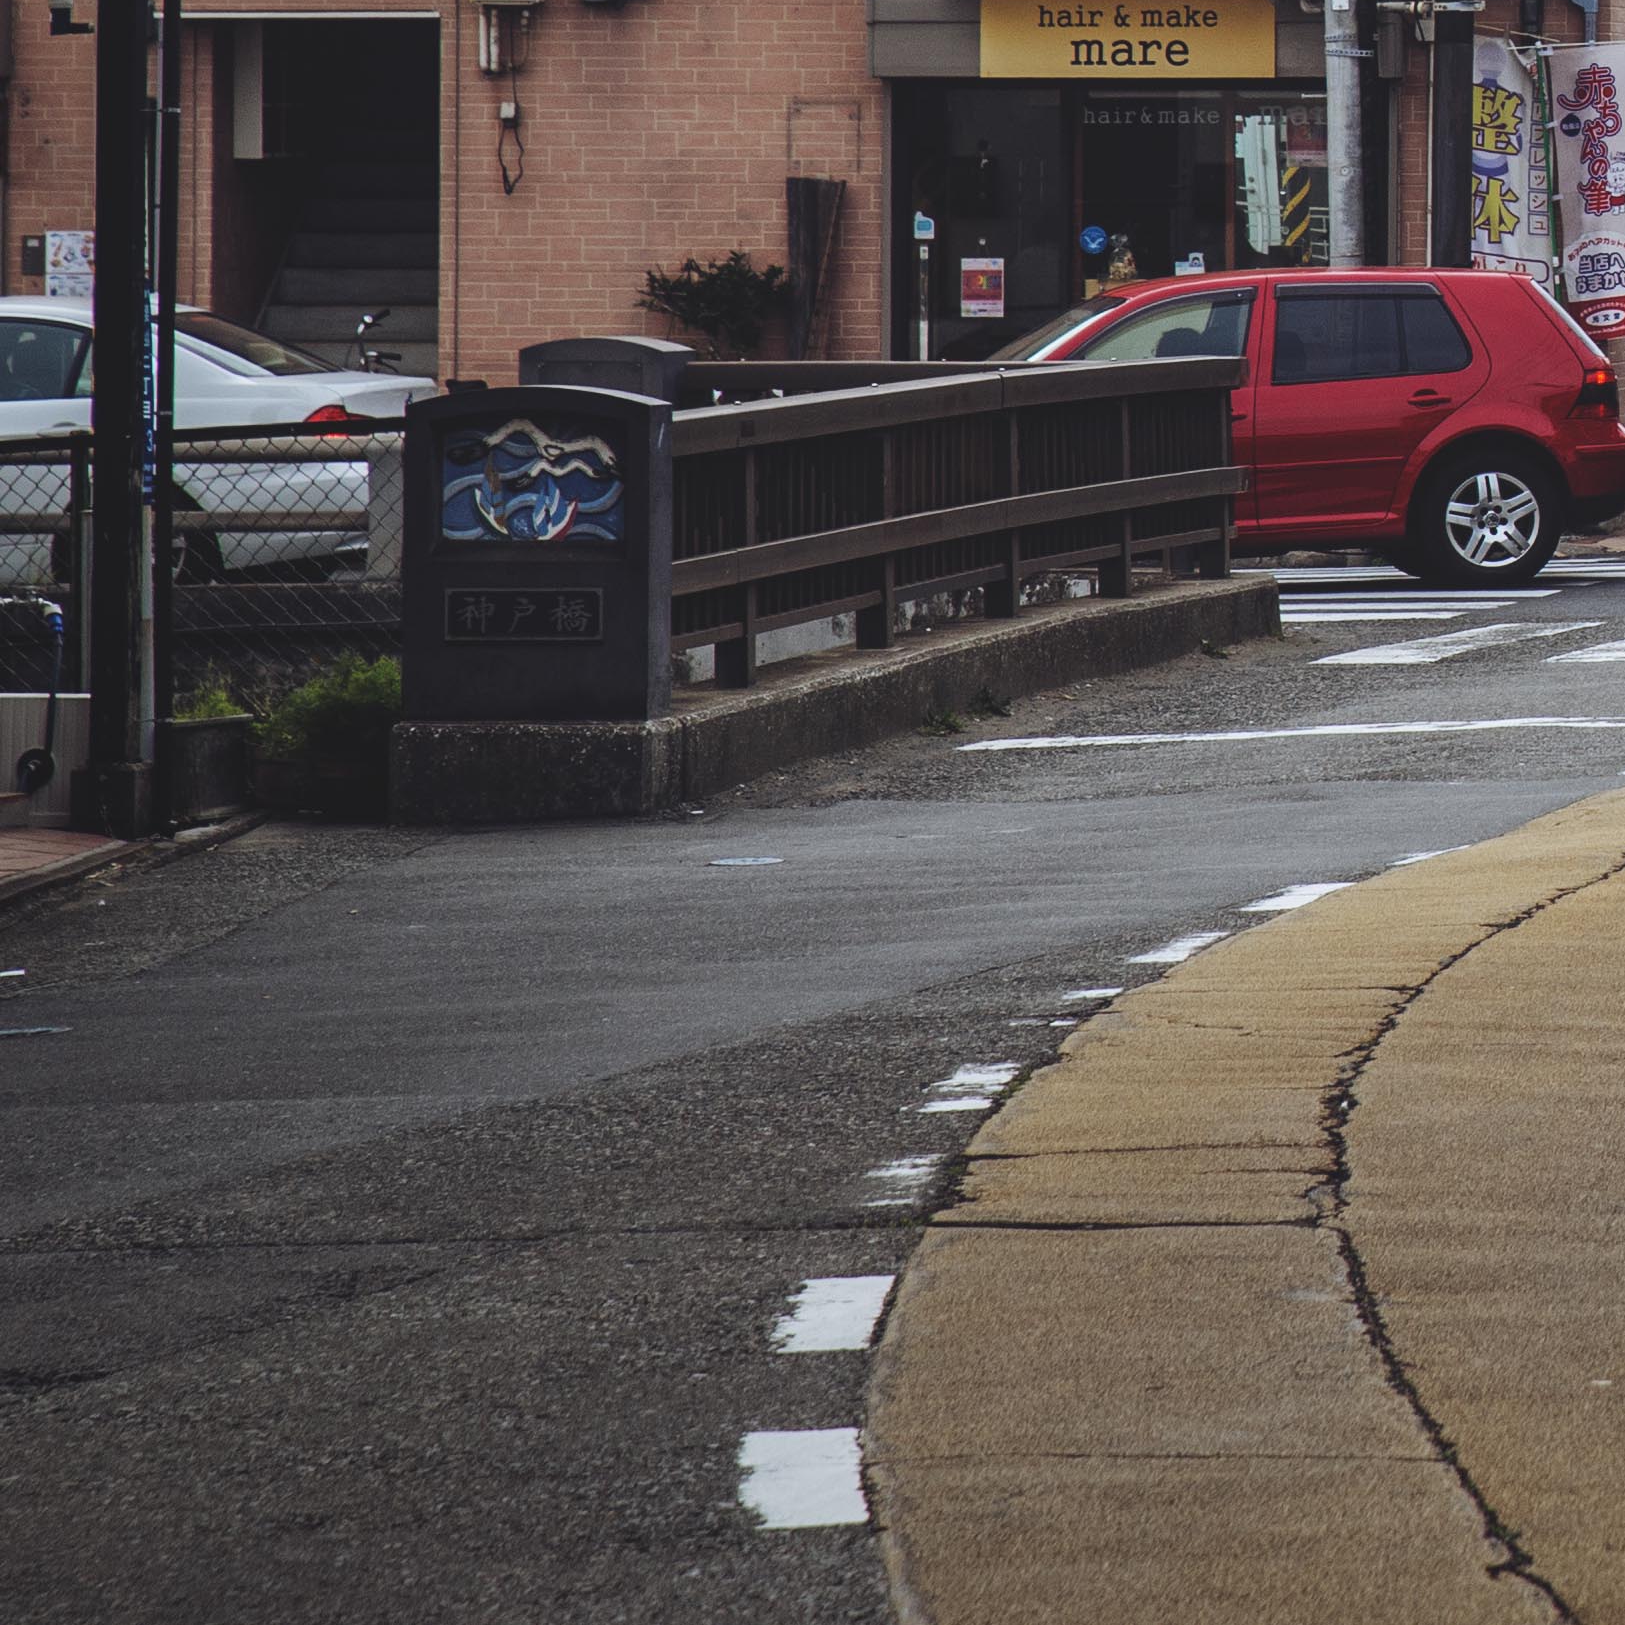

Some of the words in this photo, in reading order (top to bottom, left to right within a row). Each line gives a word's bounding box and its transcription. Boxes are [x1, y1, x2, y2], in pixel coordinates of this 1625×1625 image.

[1038, 4, 1104, 28] hair
[1113, 4, 1131, 28] &
[1140, 4, 1219, 28] make
[1069, 38, 1190, 67] mare
[1083, 105, 1139, 125] hair
[1140, 107, 1152, 124] &
[1158, 105, 1221, 125] make
[1257, 104, 1328, 126] mar
[1556, 62, 1623, 217] 赤ちゃんの筆
[455, 596, 593, 634] 神戸橋
